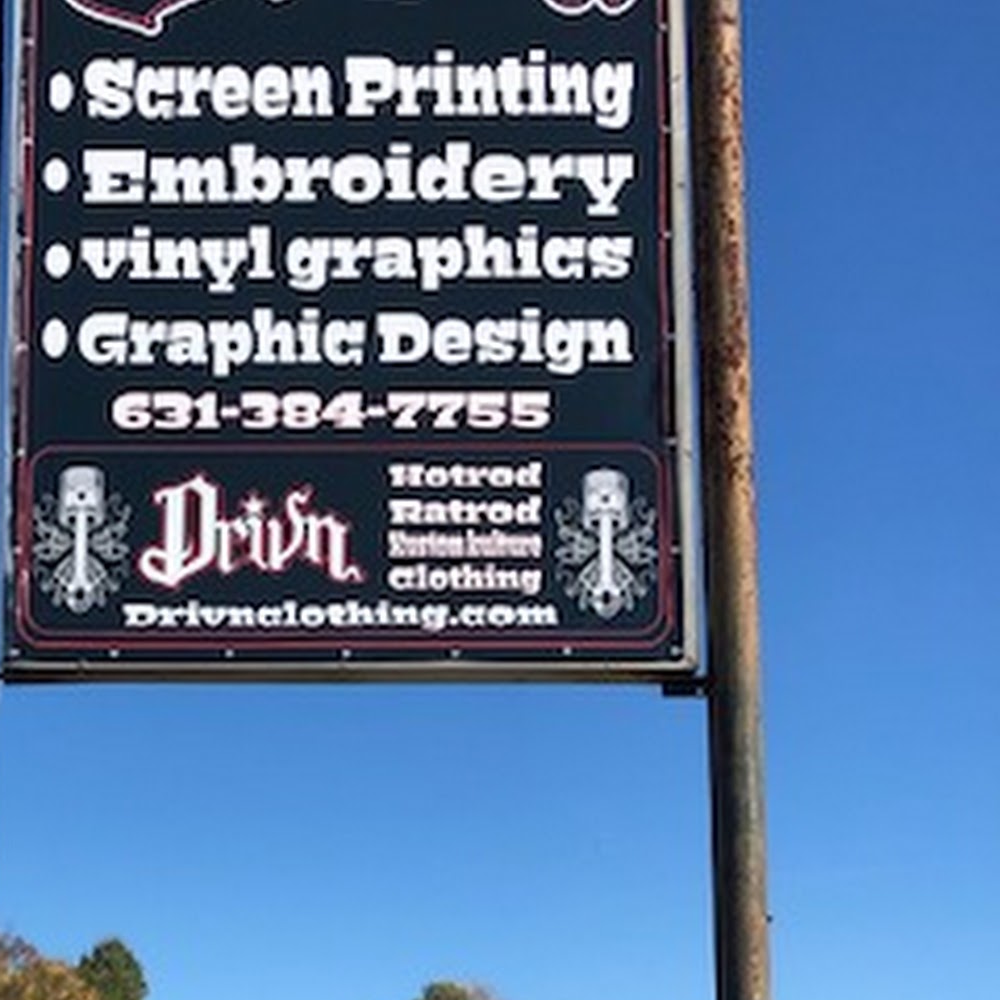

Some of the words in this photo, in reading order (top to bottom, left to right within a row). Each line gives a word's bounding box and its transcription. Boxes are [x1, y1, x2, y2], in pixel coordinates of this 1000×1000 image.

[83, 58, 334, 120] Screen
[344, 49, 634, 127] Printing
[82, 141, 634, 216] Embroidery
[80, 225, 275, 293] vinyl
[285, 224, 633, 291] graphics
[77, 307, 367, 377] Graphic
[376, 307, 633, 375] Design
[112, 391, 551, 430] 631-384-7755
[388, 461, 543, 488] Hotrod
[138, 474, 363, 588] Drivn
[388, 495, 542, 525] Ratrod
[387, 562, 542, 595] Clothing
[122, 600, 558, 631] Drivnclothing.com
